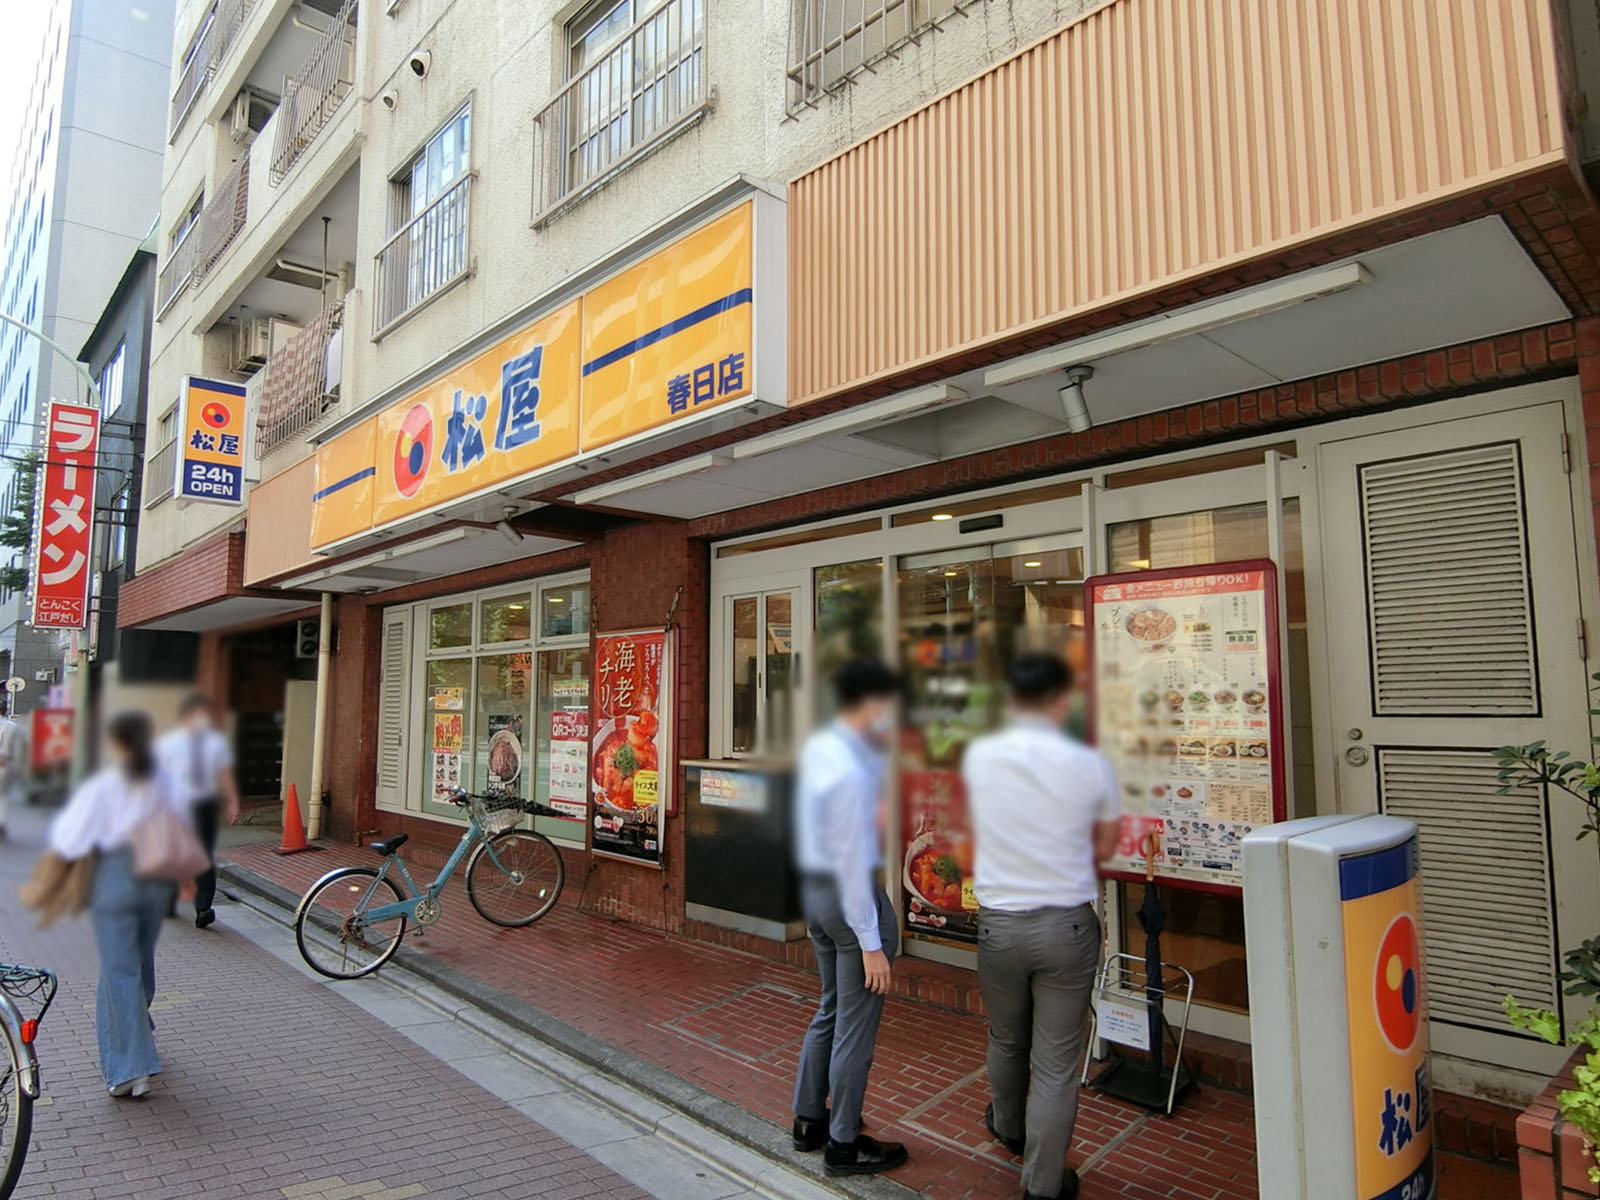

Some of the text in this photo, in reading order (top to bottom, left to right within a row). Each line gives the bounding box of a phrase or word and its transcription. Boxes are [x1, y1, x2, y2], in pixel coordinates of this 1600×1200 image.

[441, 345, 543, 473] 松屋
[667, 352, 745, 414] 春日店
[190, 429, 240, 456] 松屋
[41, 410, 96, 586] ラーメン
[191, 464, 234, 484] 24h
[191, 481, 233, 496] OPEN
[39, 611, 81, 624] 江戸だし
[599, 657, 615, 711] チリ
[614, 641, 636, 707] 海老
